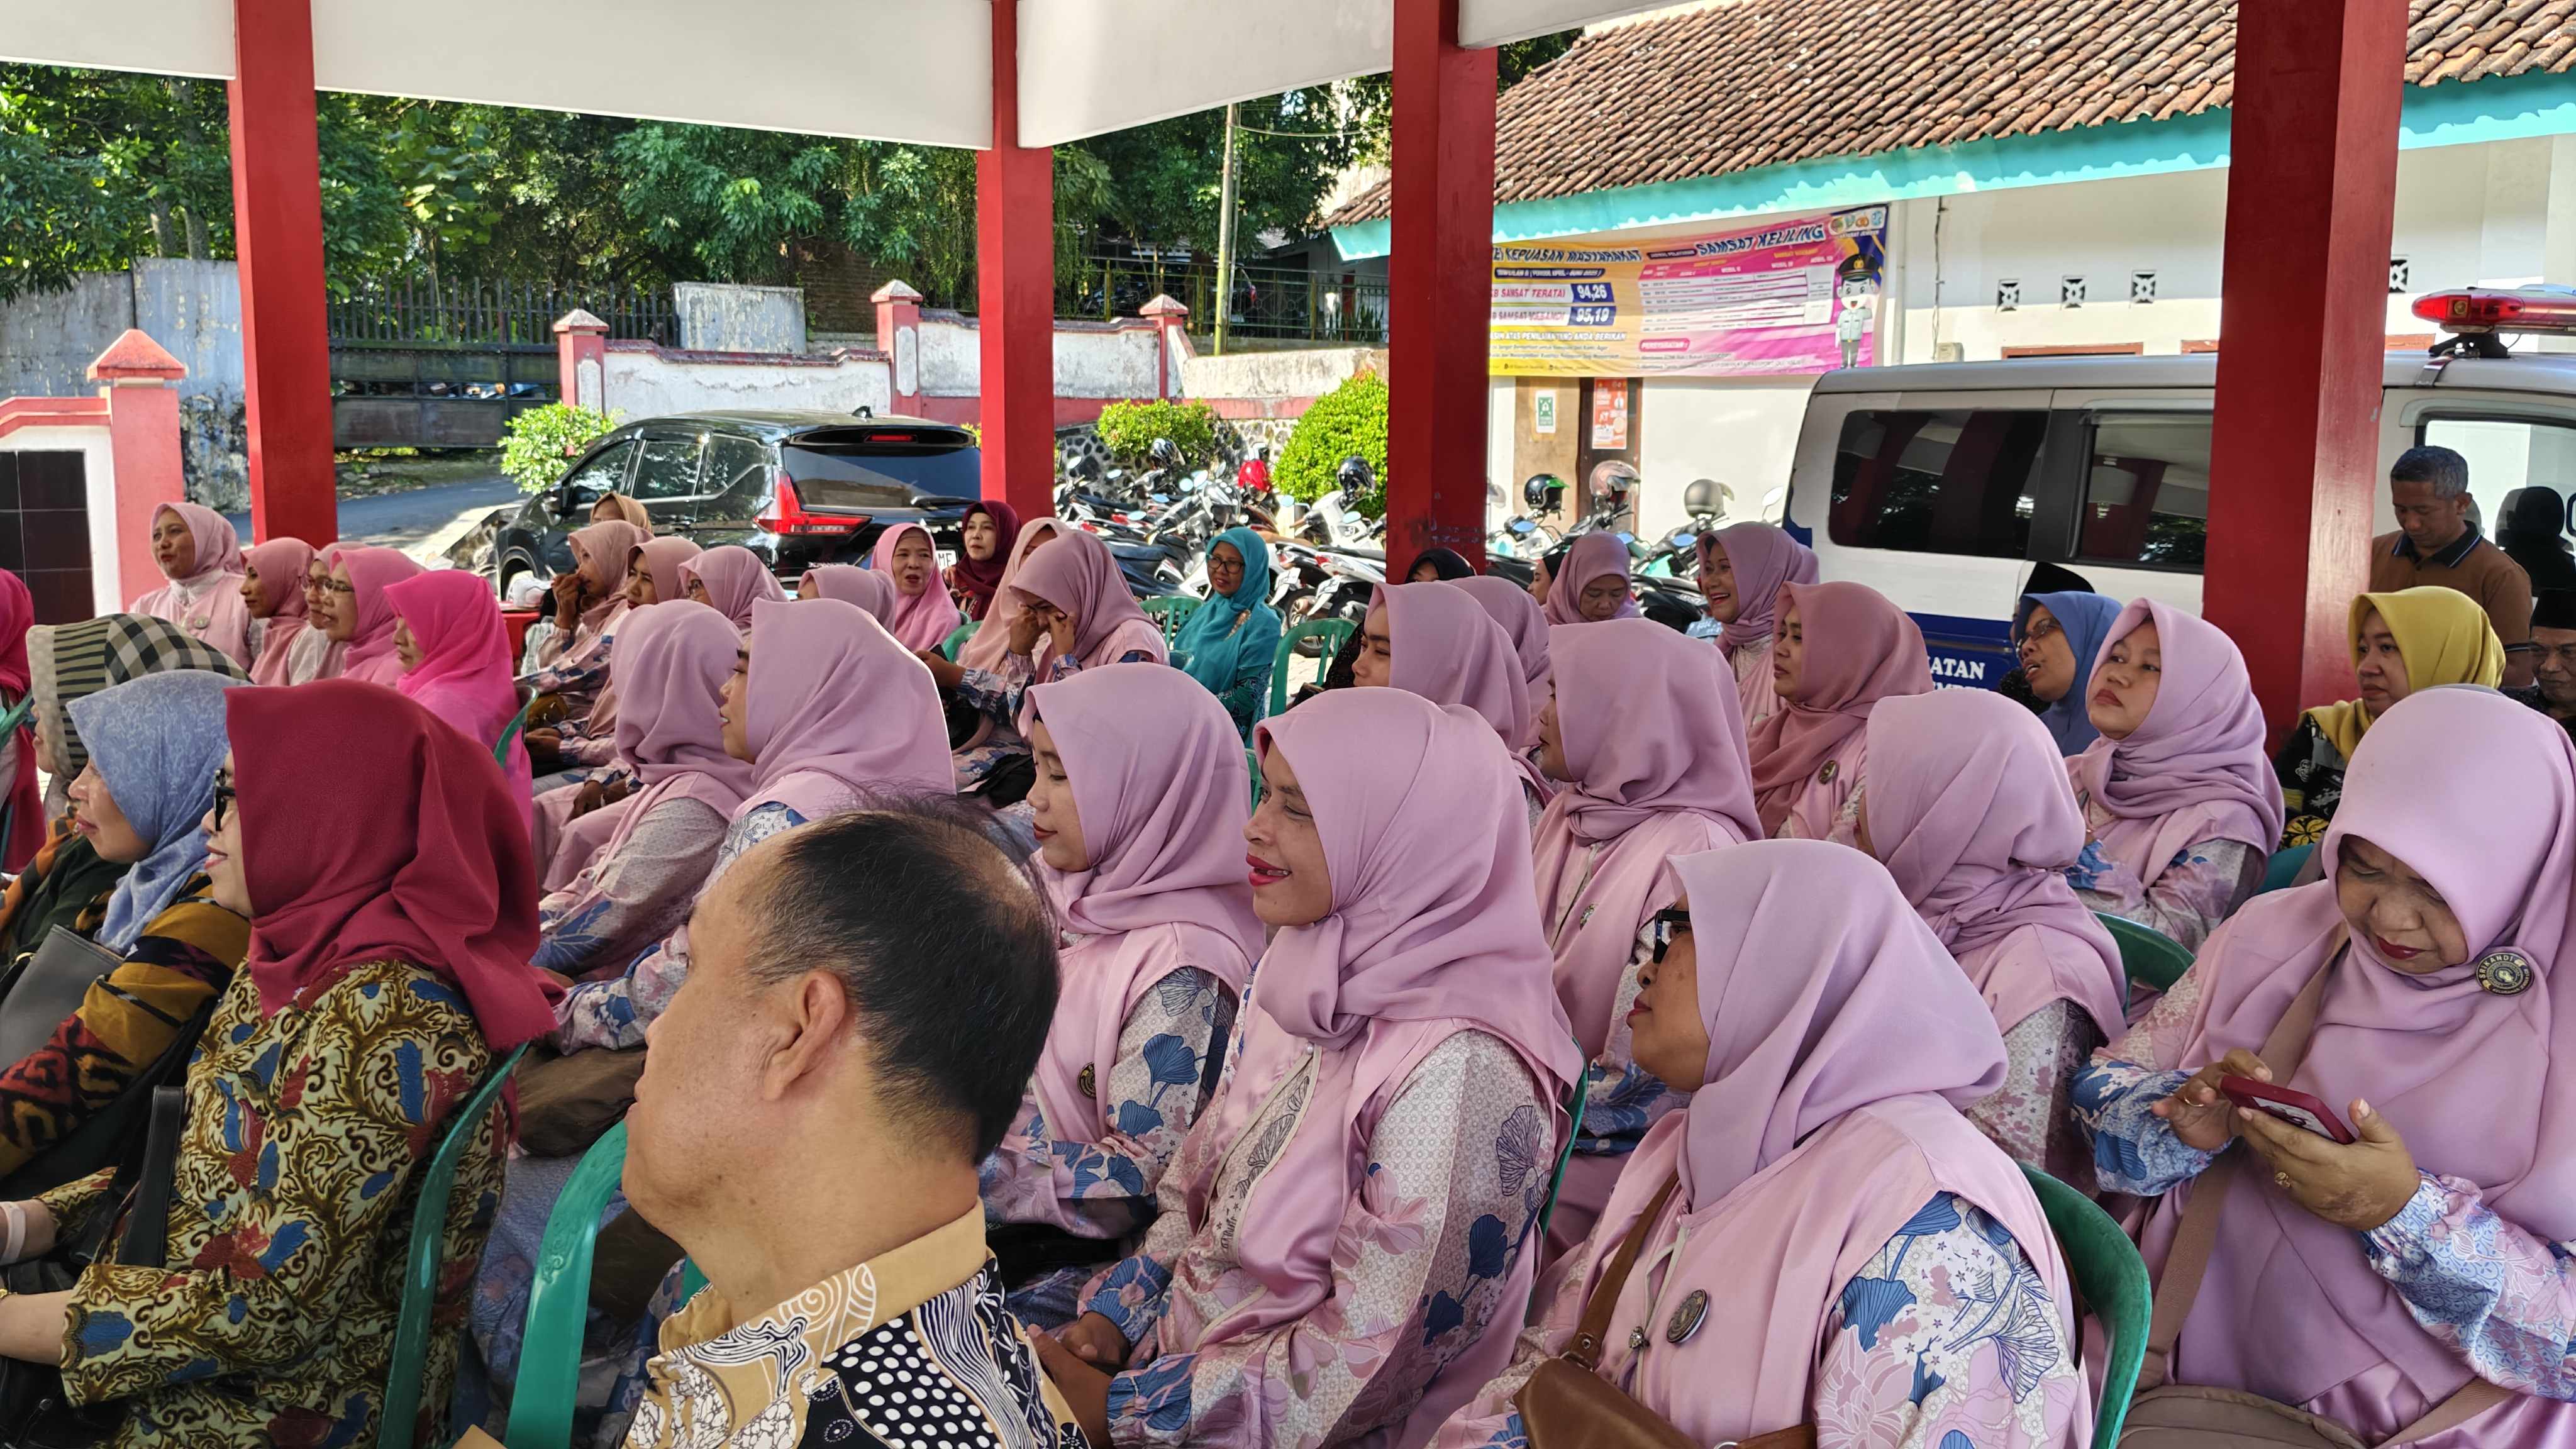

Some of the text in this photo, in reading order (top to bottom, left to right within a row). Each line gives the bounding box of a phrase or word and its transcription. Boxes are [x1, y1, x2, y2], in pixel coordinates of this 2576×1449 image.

[1696, 225, 1824, 256] SAMSAT KELILING
[1506, 248, 1565, 262] KEPUASAN
[1567, 250, 1642, 262] MASYARAKAT
[1502, 289, 1529, 297] SAMSAT
[1532, 289, 1566, 297] TERATAI
[1576, 284, 1607, 301] 94,26
[1575, 308, 1610, 324] 95,19
[1928, 656, 1985, 680] ATAN
[2479, 955, 2515, 979] SRIKANDI
